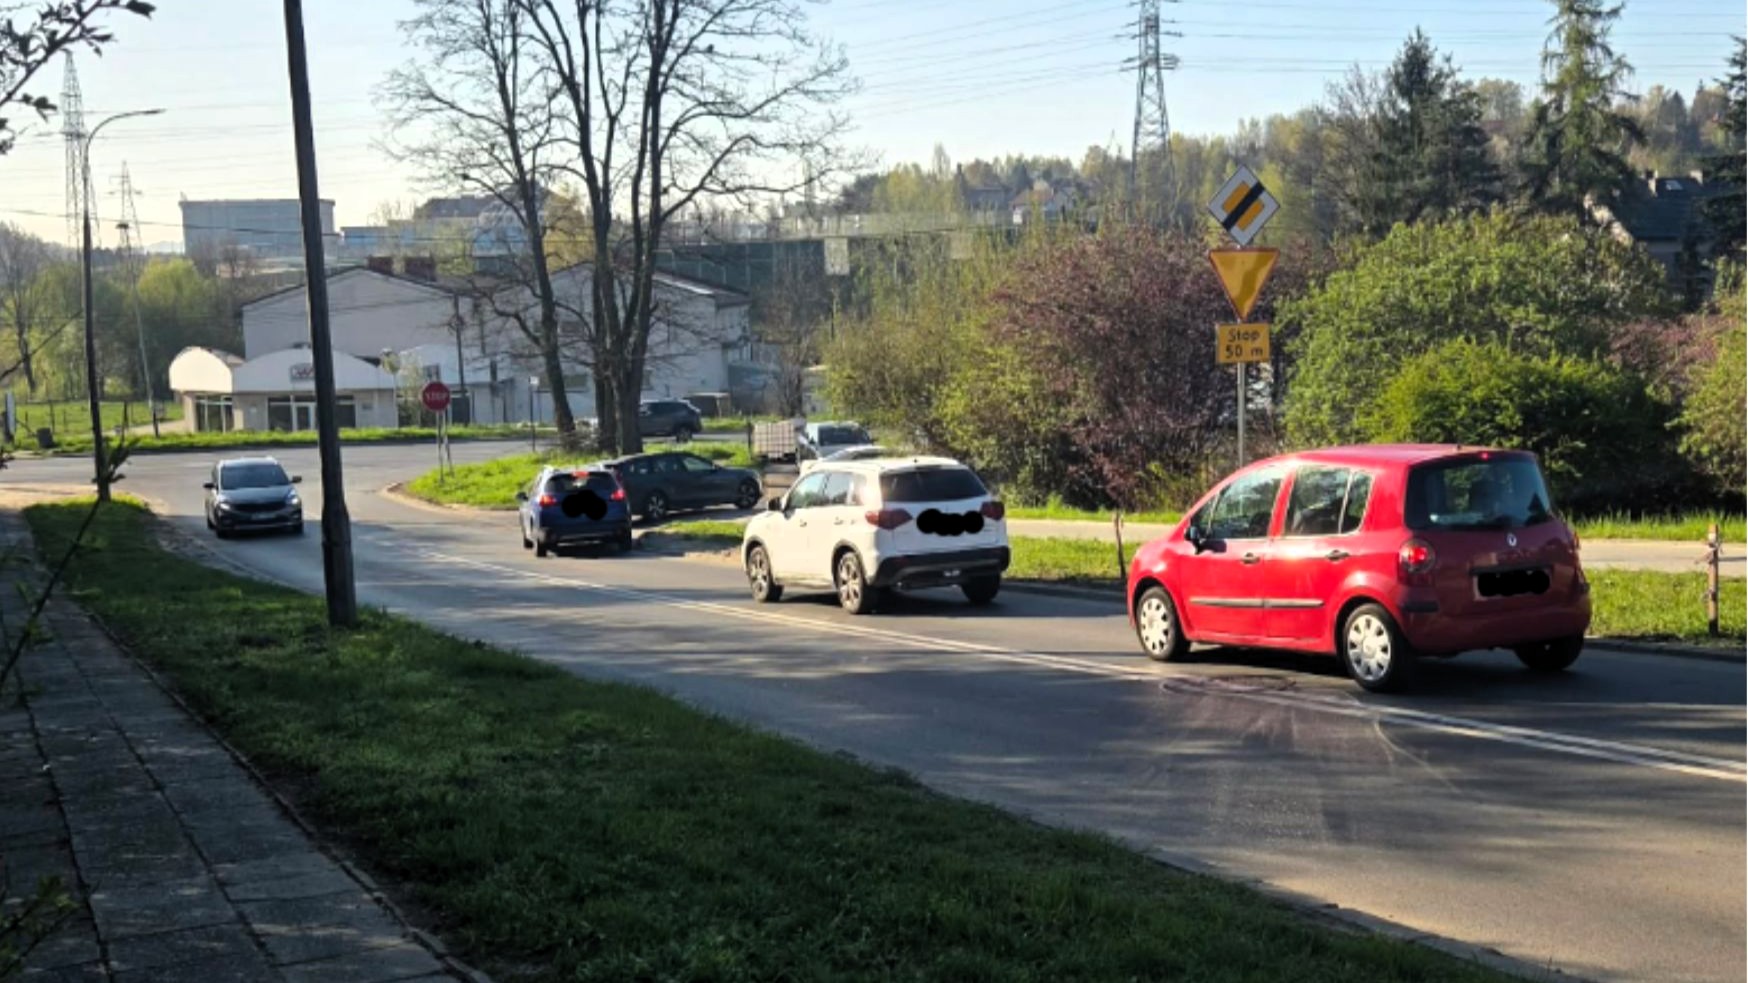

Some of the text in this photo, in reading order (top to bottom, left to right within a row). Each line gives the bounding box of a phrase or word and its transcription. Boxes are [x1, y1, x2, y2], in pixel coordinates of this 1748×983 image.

[1228, 328, 1260, 342] Stop
[1225, 344, 1264, 359] 50 m
[424, 391, 448, 401] STOP
